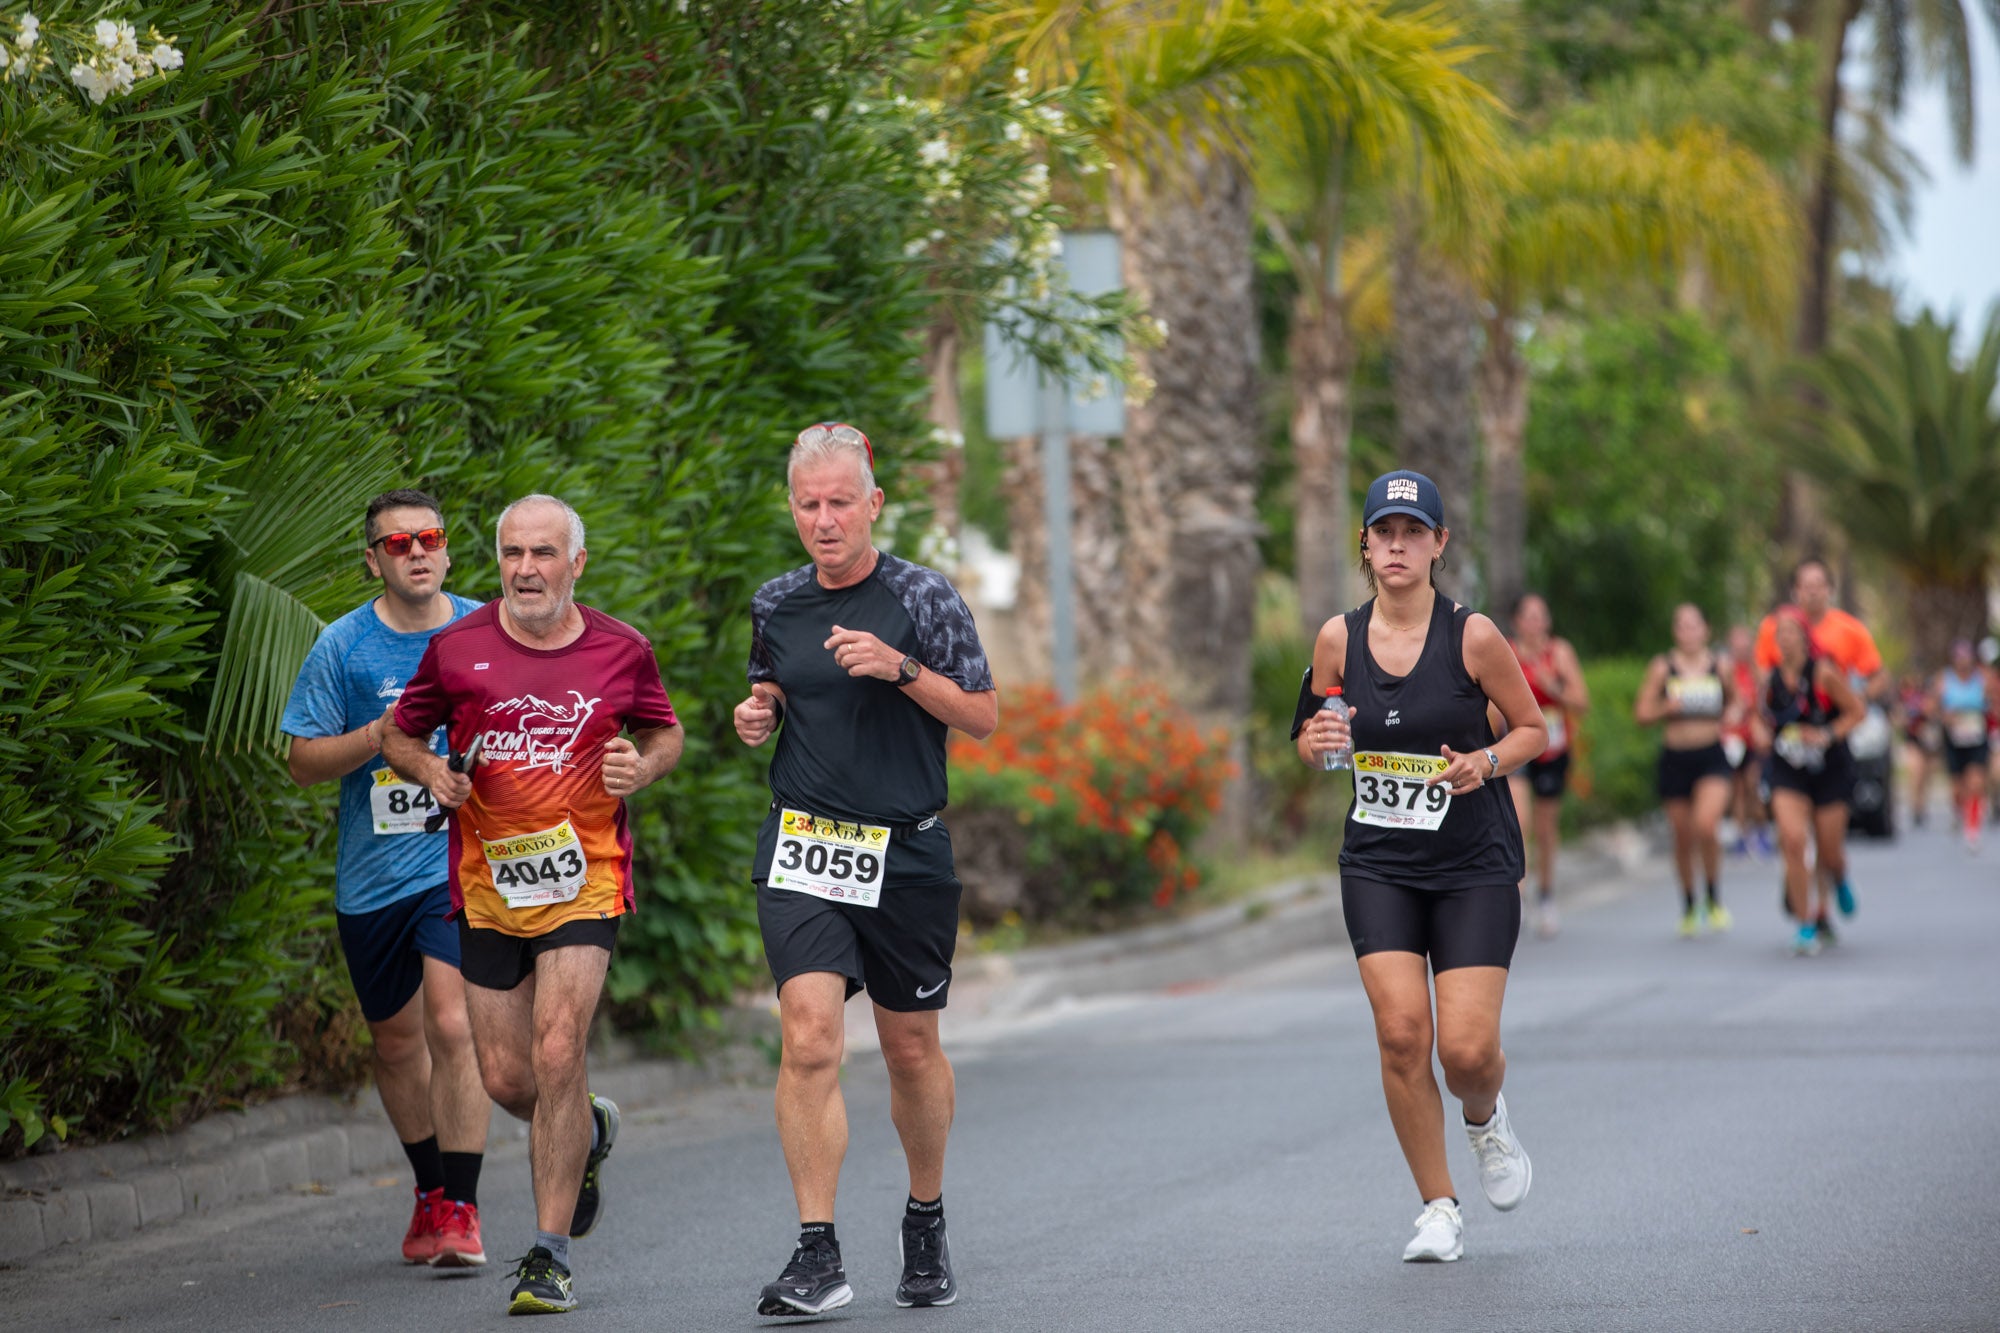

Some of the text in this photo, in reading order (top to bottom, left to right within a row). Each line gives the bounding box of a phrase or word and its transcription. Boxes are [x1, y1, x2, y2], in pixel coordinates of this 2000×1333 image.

[1388, 479, 1417, 489] MUTUA
[1386, 492, 1418, 502] OPEN
[555, 727, 575, 735] 2024
[482, 730, 526, 751] CXM
[513, 751, 528, 760] DEL
[1368, 755, 1433, 775] 38 FONDO
[1360, 776, 1447, 813] 3379
[812, 825, 866, 842] FONDO
[491, 844, 509, 856] 38
[507, 838, 555, 856] FONDO
[496, 849, 583, 888] 4043
[778, 840, 879, 884] 3059
